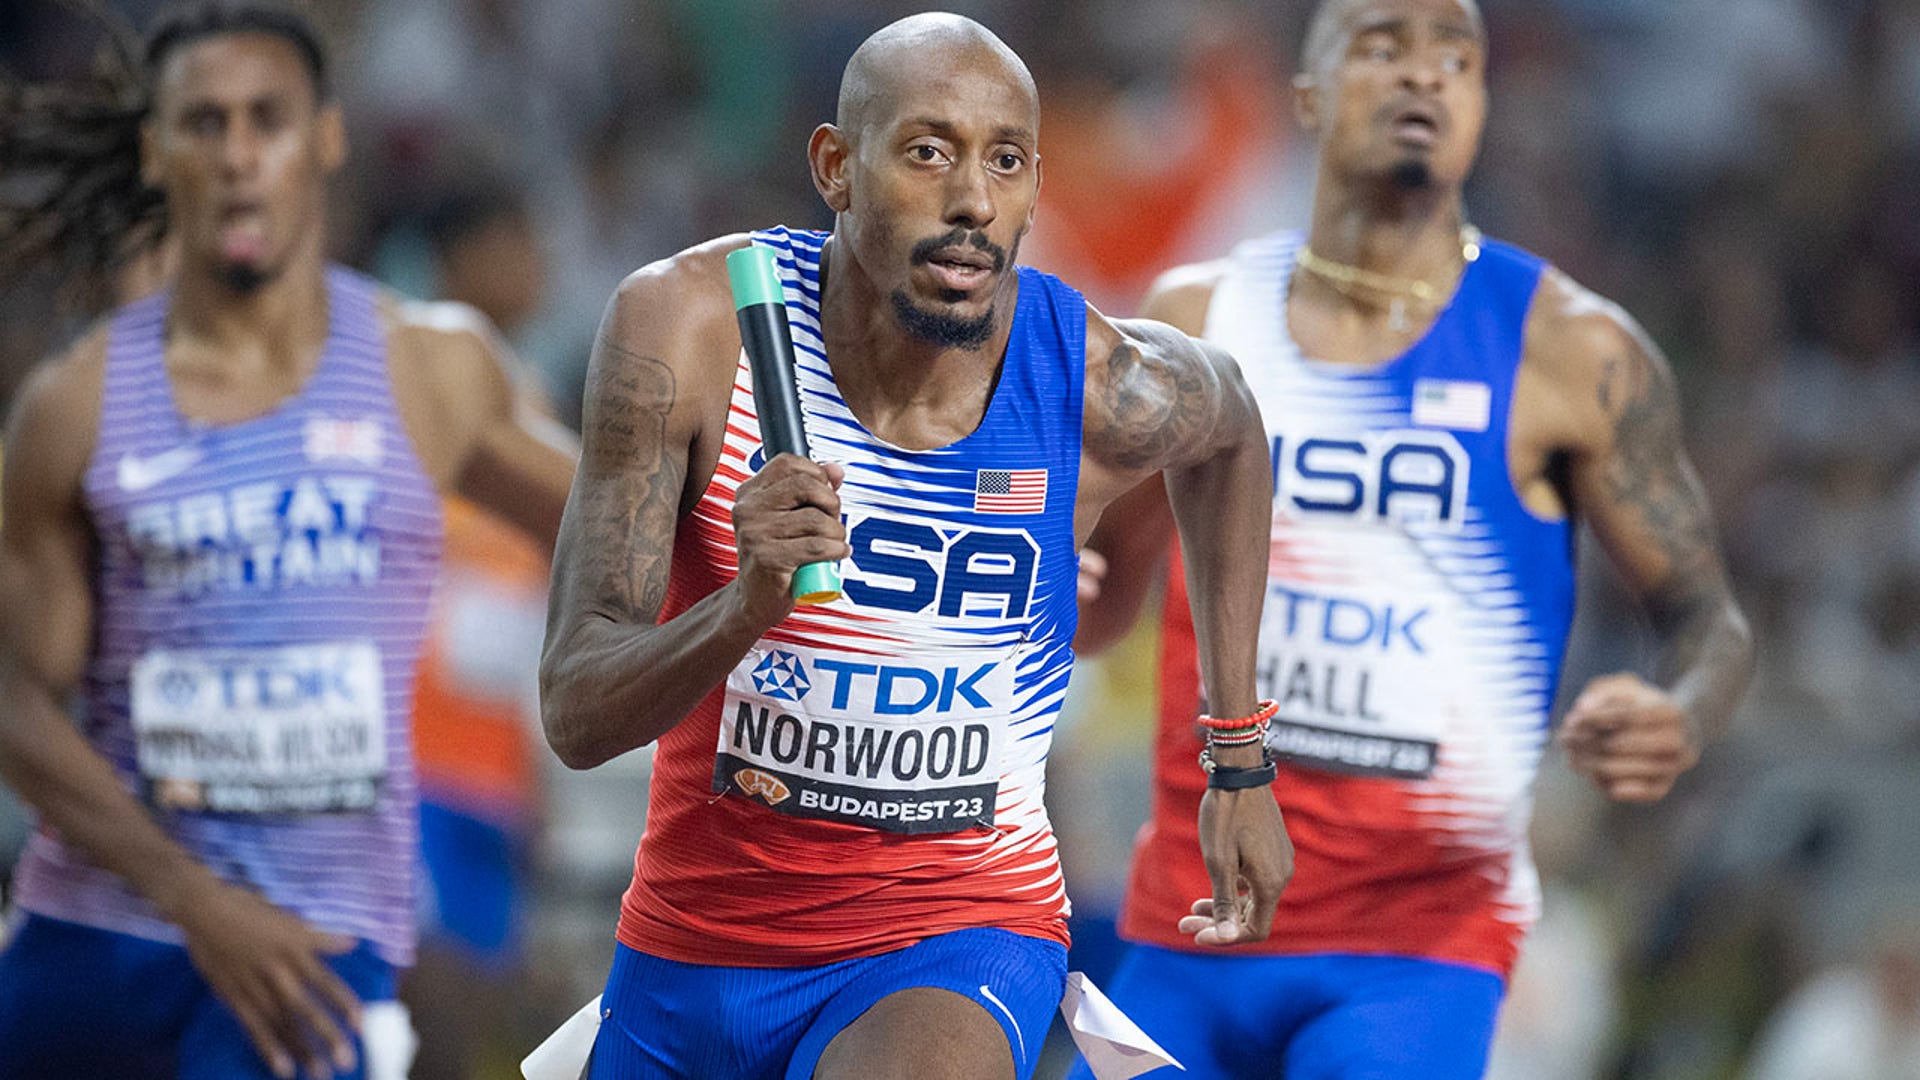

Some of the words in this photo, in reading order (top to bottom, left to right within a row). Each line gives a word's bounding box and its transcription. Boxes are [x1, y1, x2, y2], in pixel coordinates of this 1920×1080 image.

[838, 511, 1039, 621] SA
[1270, 586, 1432, 655] TDK
[209, 660, 358, 708] TDK
[812, 658, 1000, 716] TDK
[733, 702, 990, 781] NORWOOD
[799, 789, 950, 822] BUDAPEST
[952, 797, 984, 819] 23
